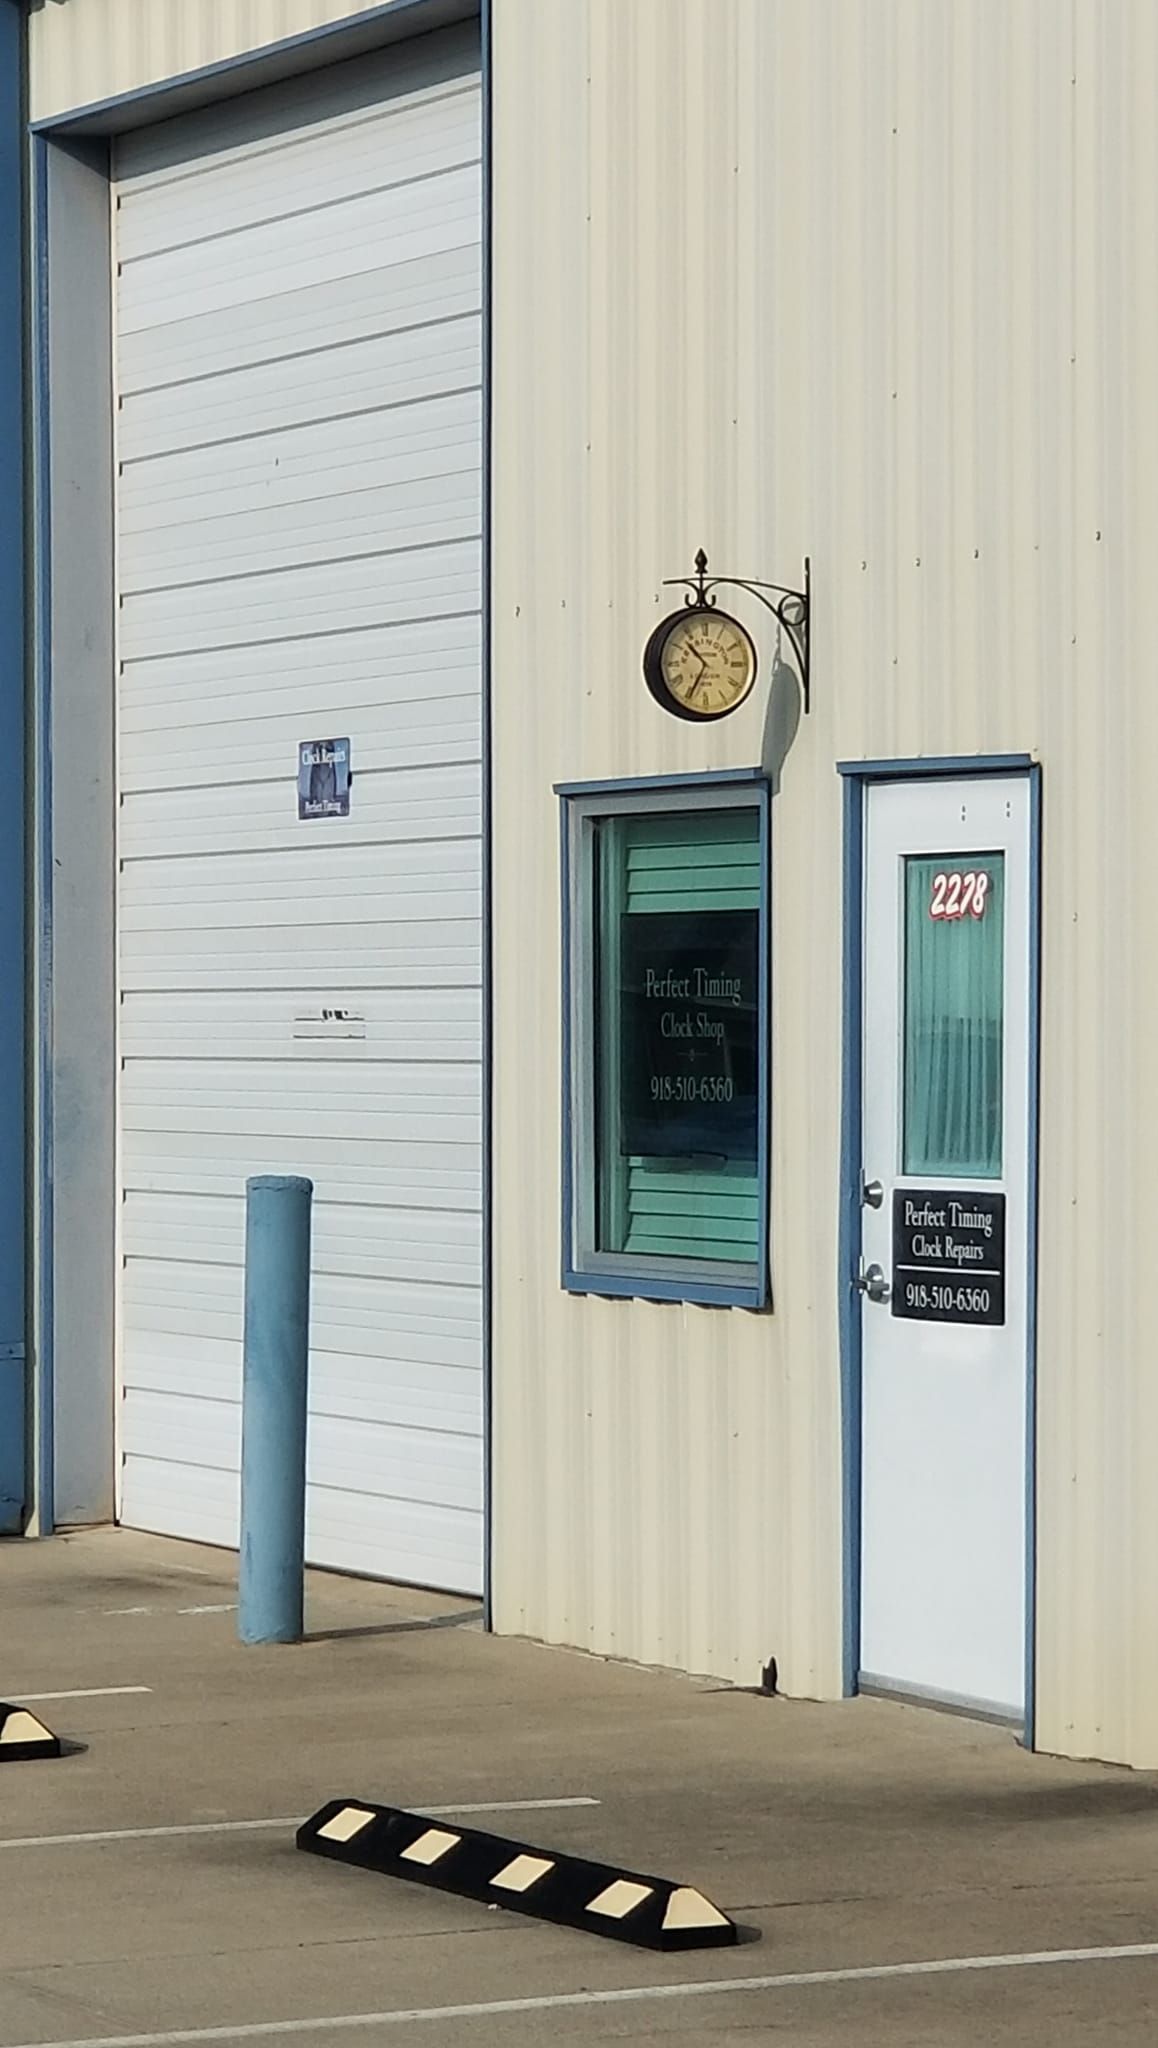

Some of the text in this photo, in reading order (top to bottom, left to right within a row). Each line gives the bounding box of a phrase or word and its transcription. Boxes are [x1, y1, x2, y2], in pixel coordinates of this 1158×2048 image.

[681, 638, 729, 665] KESINGTON
[929, 871, 989, 918] 2278
[646, 967, 742, 1006] Perfect Timing
[661, 1011, 725, 1046] Clock Shop
[650, 1076, 733, 1102] 918-510-6360
[904, 1200, 993, 1238] Perfect Timing
[912, 1234, 985, 1266] Clock Repairs
[906, 1283, 990, 1313] 918-510-6360
